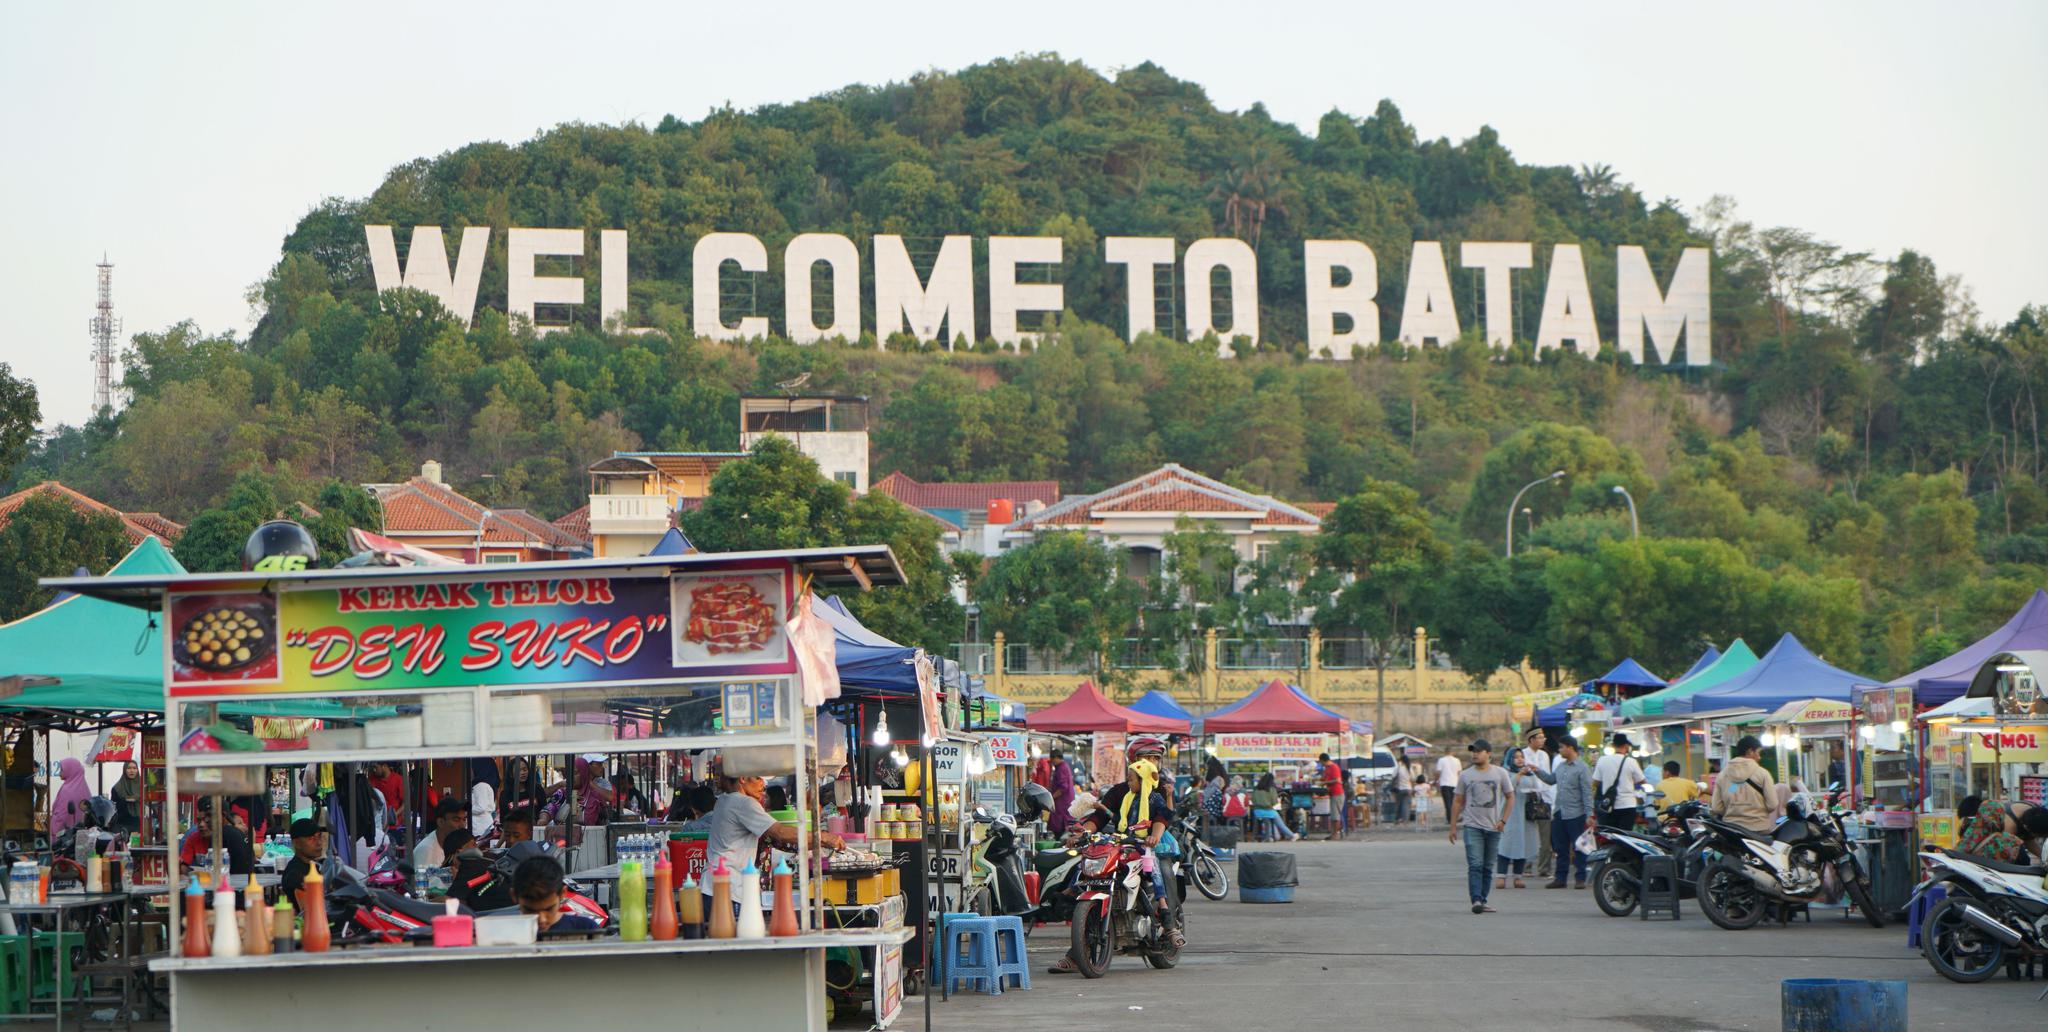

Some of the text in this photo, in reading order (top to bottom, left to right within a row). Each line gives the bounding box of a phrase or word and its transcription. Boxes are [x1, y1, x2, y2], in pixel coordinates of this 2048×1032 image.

[364, 225, 1711, 365] WELCOME TO BATAM
[254, 555, 308, 571] 46
[337, 577, 614, 613] KERAK TELOR
[1805, 710, 1835, 719] KERAK
[1273, 736, 1322, 747] BAKAR
[1983, 733, 2038, 749] CMOL
